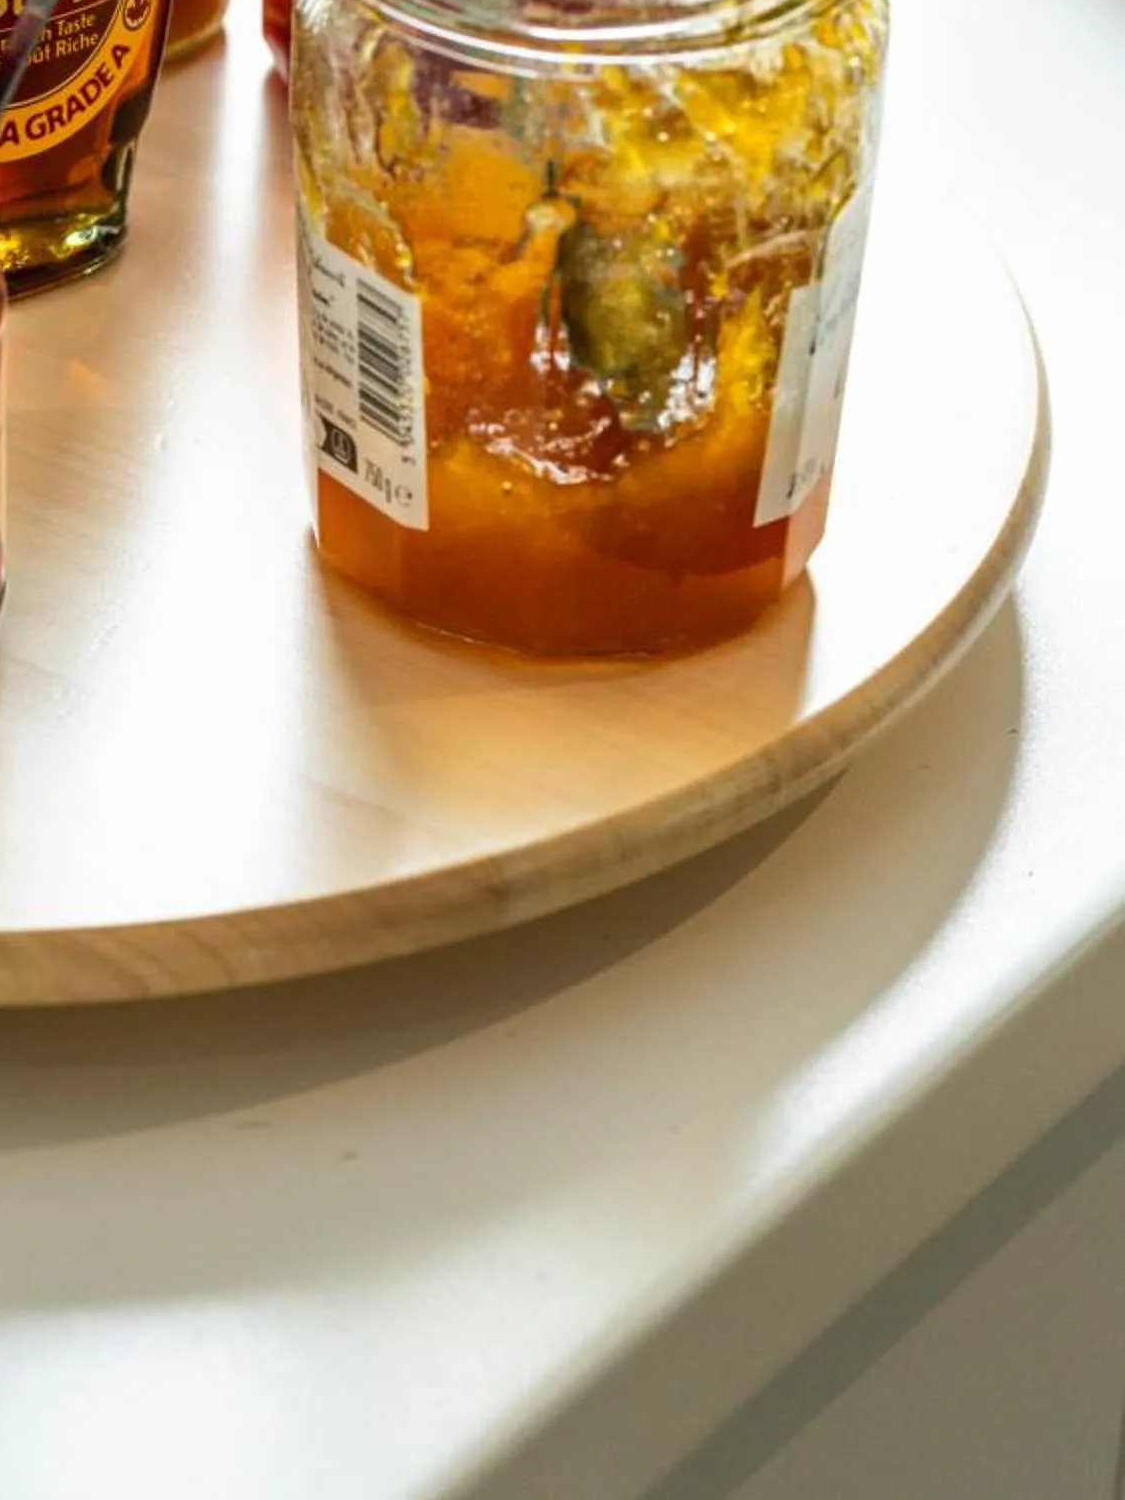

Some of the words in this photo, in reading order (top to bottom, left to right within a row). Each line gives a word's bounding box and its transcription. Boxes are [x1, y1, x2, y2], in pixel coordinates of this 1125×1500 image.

[56, 13, 96, 36] Taste
[55, 32, 99, 58] Riche
[25, 61, 115, 140] GRADE
[111, 44, 131, 70] A
